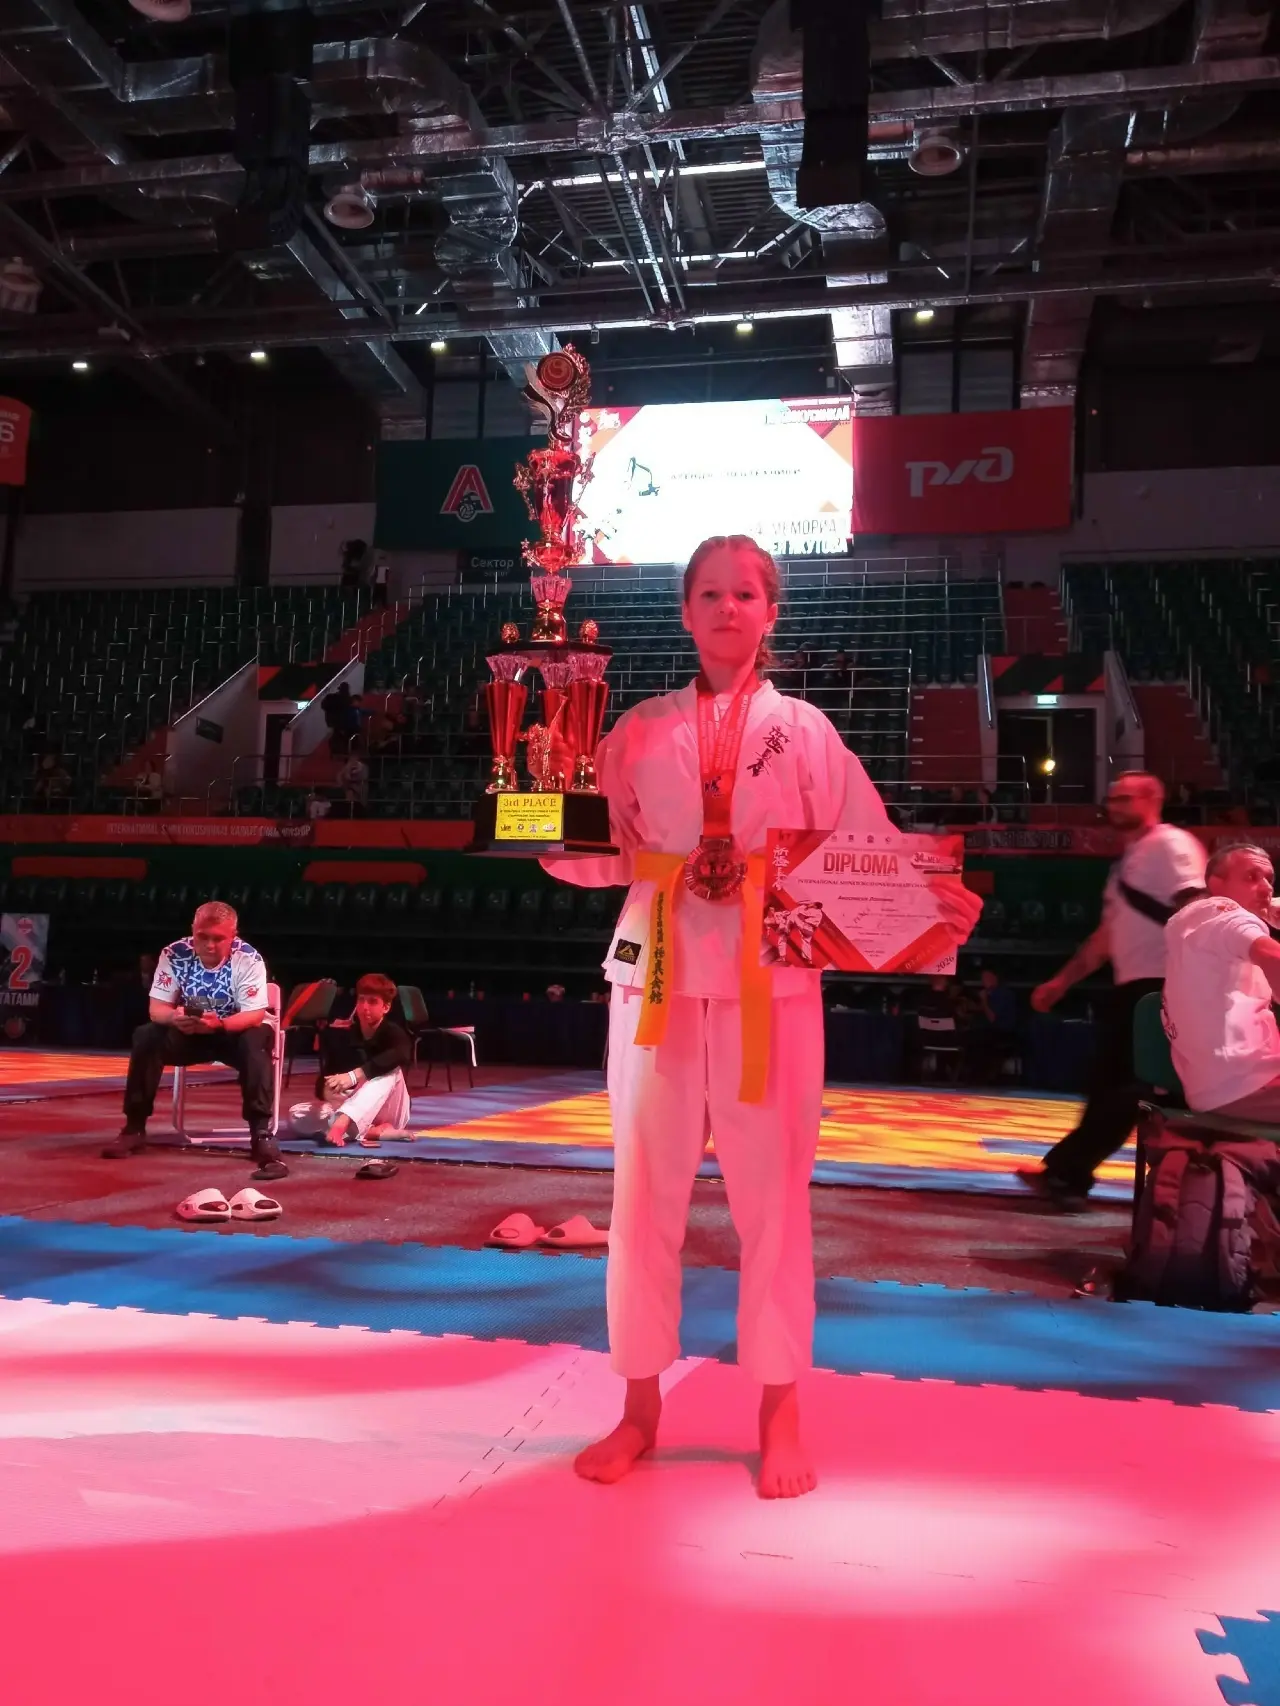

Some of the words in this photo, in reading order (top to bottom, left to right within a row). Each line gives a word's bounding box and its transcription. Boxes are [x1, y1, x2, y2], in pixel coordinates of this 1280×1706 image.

[772, 518, 846, 536] МЕМОРИА
[471, 556, 514, 569] Сектор
[503, 798, 519, 807] 3rd
[523, 798, 557, 807] PLACE
[823, 852, 899, 874] DIPLOMA
[797, 878, 838, 886] INTERNATIONAL
[9, 945, 32, 989] 2
